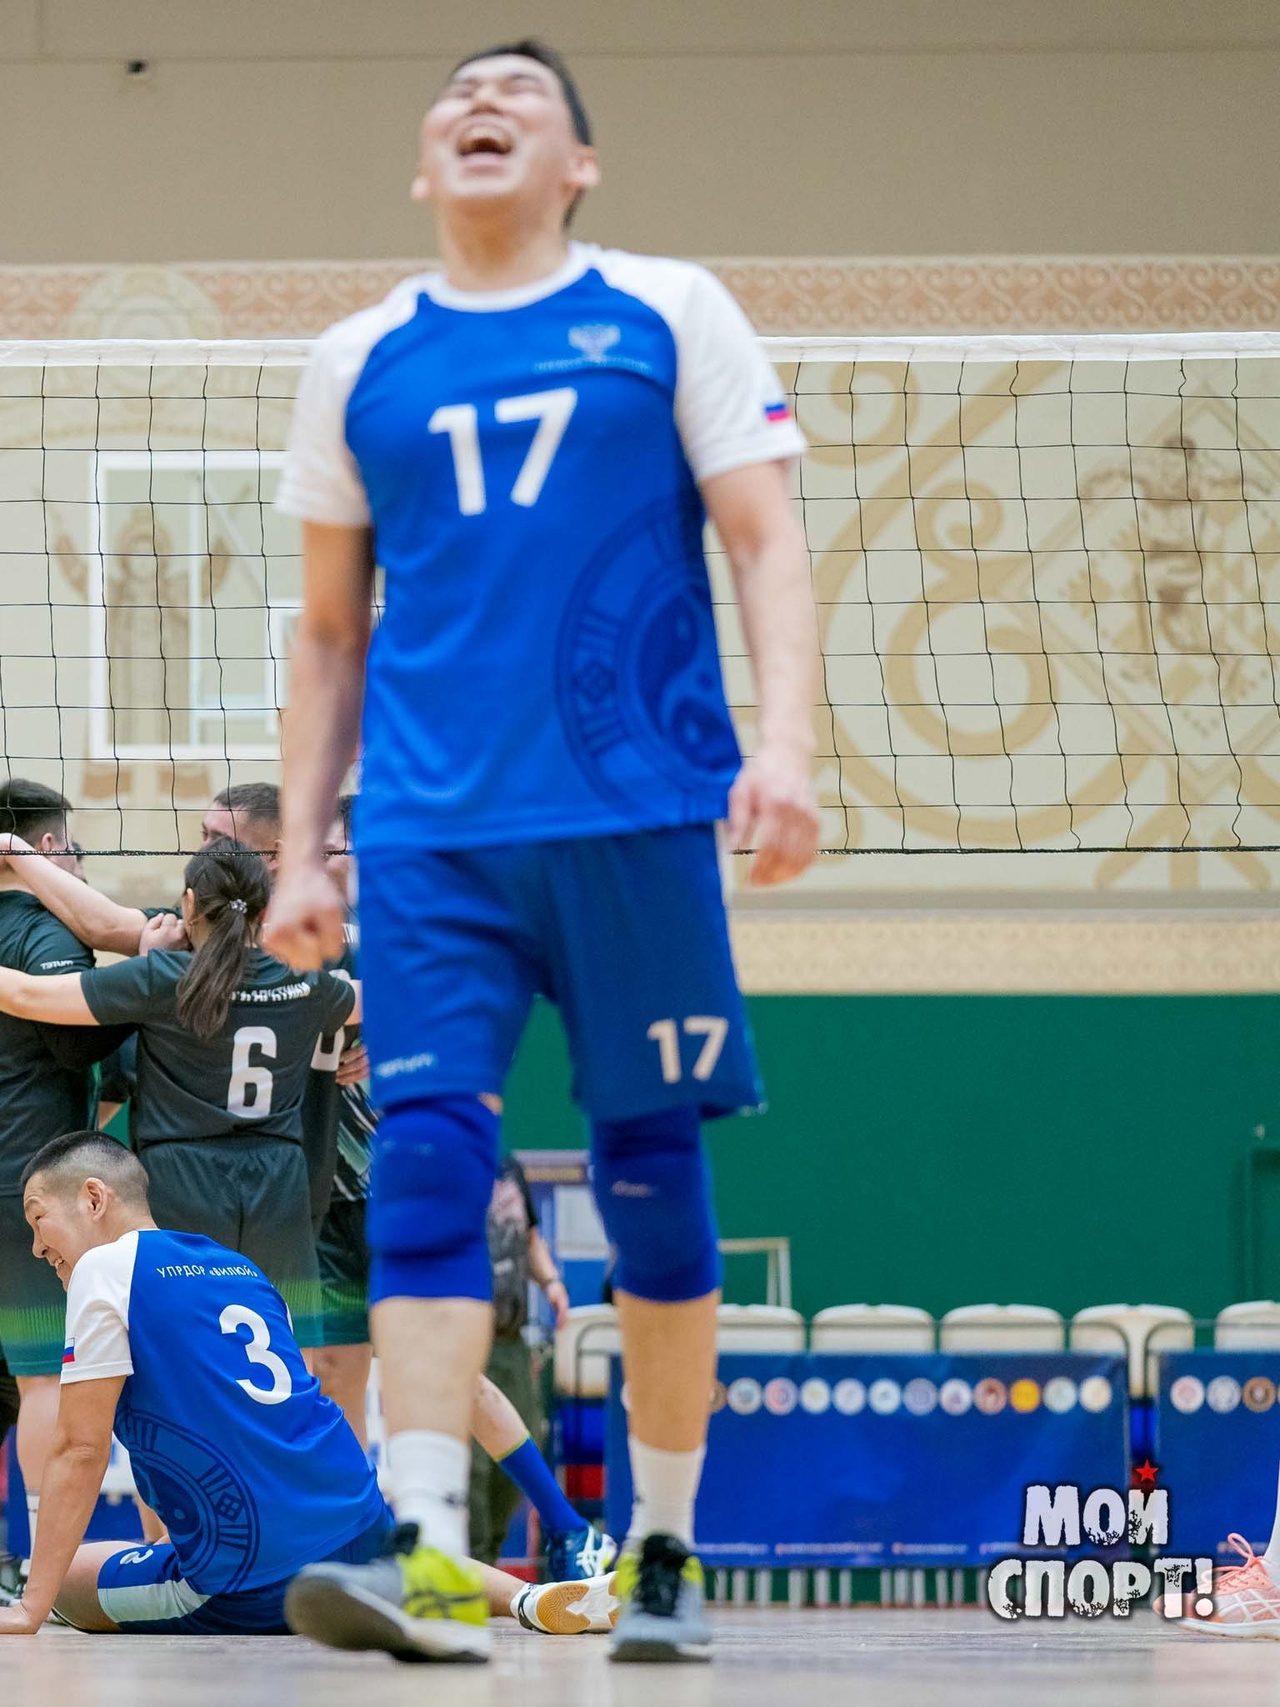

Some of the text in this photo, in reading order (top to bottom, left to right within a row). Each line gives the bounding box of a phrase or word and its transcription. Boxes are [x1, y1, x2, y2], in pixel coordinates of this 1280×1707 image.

[428, 388, 577, 516] 17
[227, 1026, 277, 1119] 6
[647, 1016, 730, 1084] 17
[156, 1264, 207, 1279] УПРДОР
[219, 1303, 294, 1405] 3
